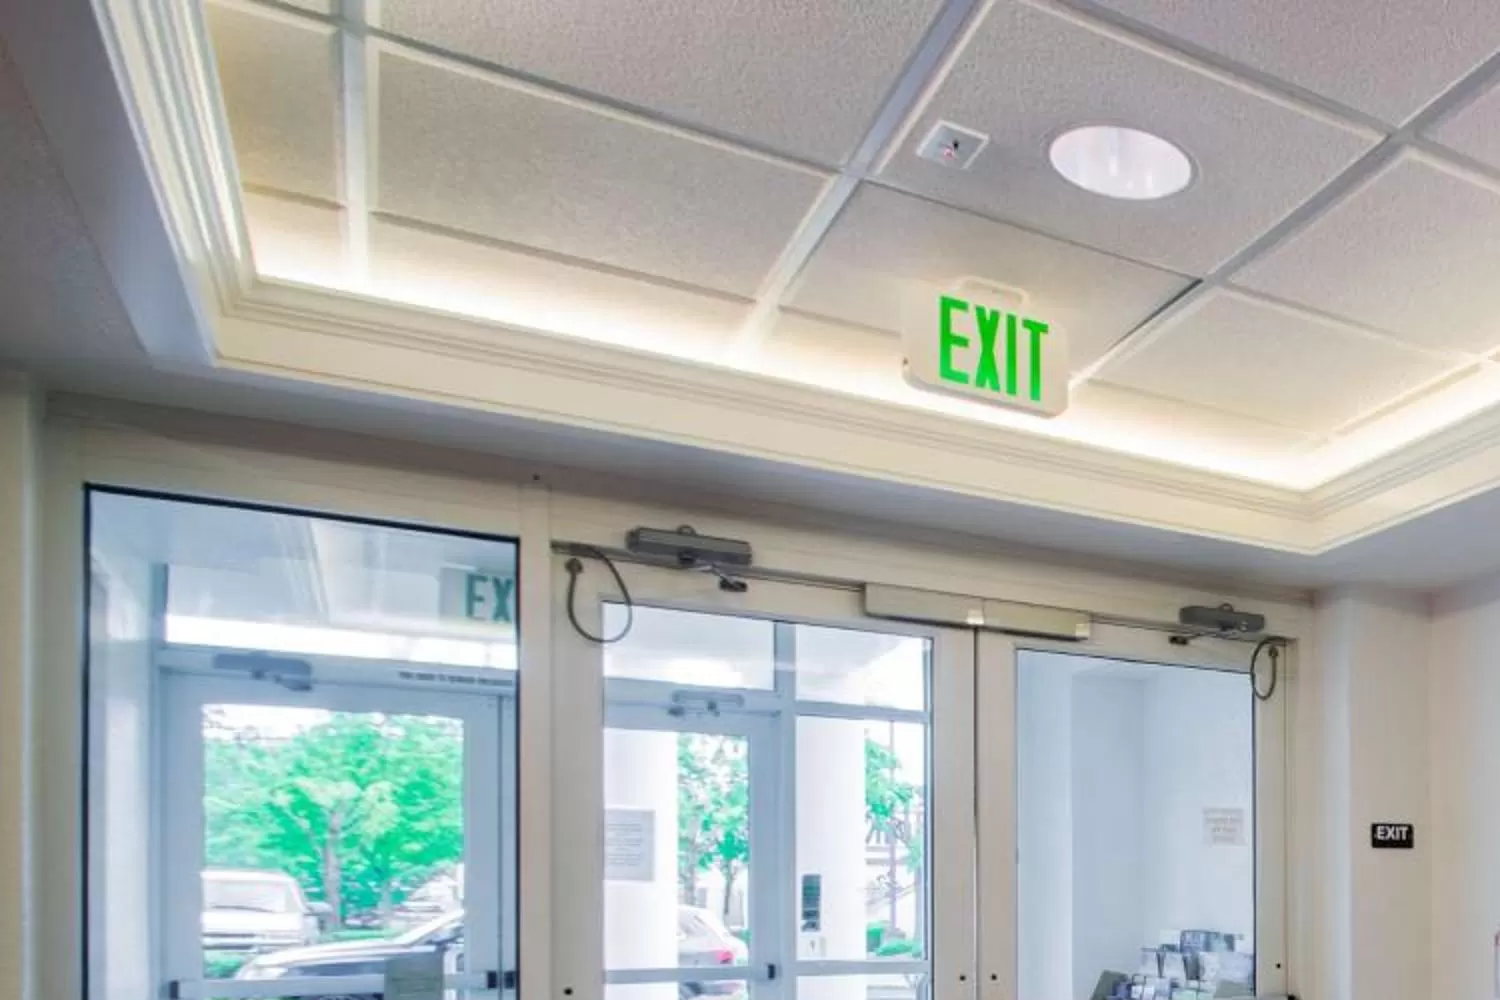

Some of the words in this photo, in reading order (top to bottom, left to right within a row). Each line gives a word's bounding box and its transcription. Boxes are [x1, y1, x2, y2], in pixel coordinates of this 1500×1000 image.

[937, 295, 1049, 402] EXIT
[466, 573, 514, 622] EX
[1377, 825, 1409, 841] EXIT
